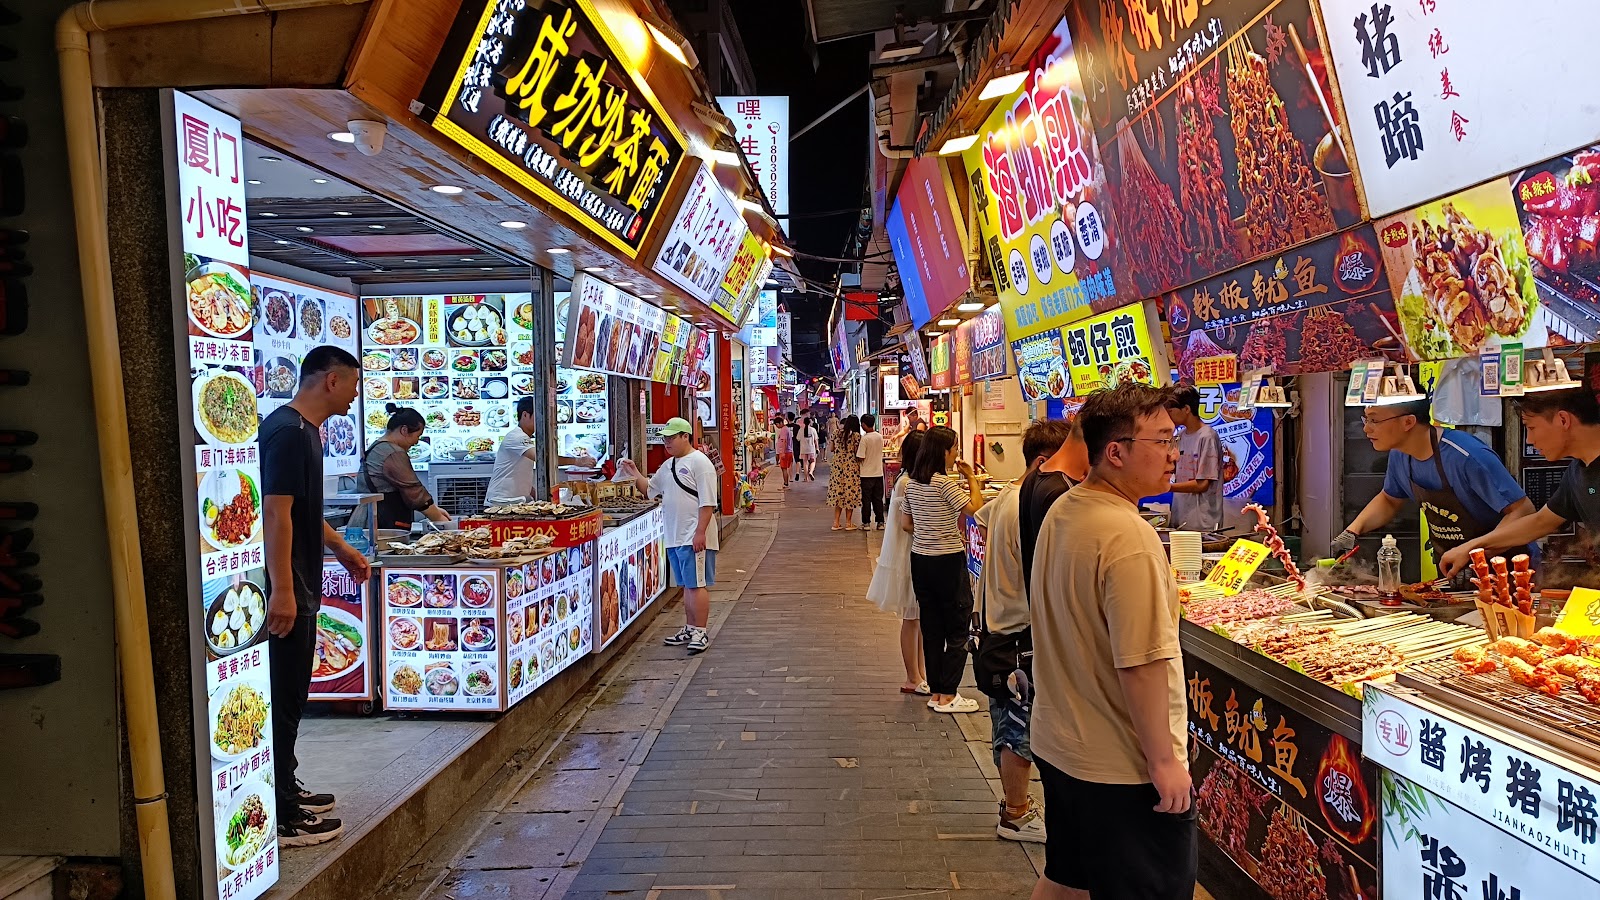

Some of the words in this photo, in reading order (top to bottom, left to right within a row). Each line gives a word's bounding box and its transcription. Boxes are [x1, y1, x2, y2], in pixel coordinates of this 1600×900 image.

[1353, 2, 1425, 170] 猪蹄
[505, 8, 670, 213] 成功沙茶面
[182, 113, 239, 184] 厦门
[1520, 177, 1556, 201] 麻辣味
[186, 186, 244, 248] 小吃
[1383, 229, 1408, 245] 香辣味
[1192, 256, 1328, 322] 铁板鱿鱼
[1339, 252, 1374, 281] 爆
[1252, 300, 1308, 319] 细品百味人生!
[193, 340, 251, 362] 招牌沙茶面
[1067, 315, 1142, 367] 蚵仔煎
[200, 447, 257, 468] 厦门海蛎煎
[206, 547, 262, 575] 台湾卤肉饭
[217, 649, 261, 682] 蟹黄汤包
[1186, 720, 1213, 748] 色美食
[1379, 718, 1409, 749] 专业
[217, 746, 271, 791] 厦门炒面线
[1219, 742, 1282, 795] 细品百味人生!
[1419, 718, 1599, 845] 酱烤猪蹄
[1324, 767, 1362, 822] 爆
[1492, 808, 1588, 866] JIANKAOZHUTI
[222, 847, 275, 900] 北京炸酱面
